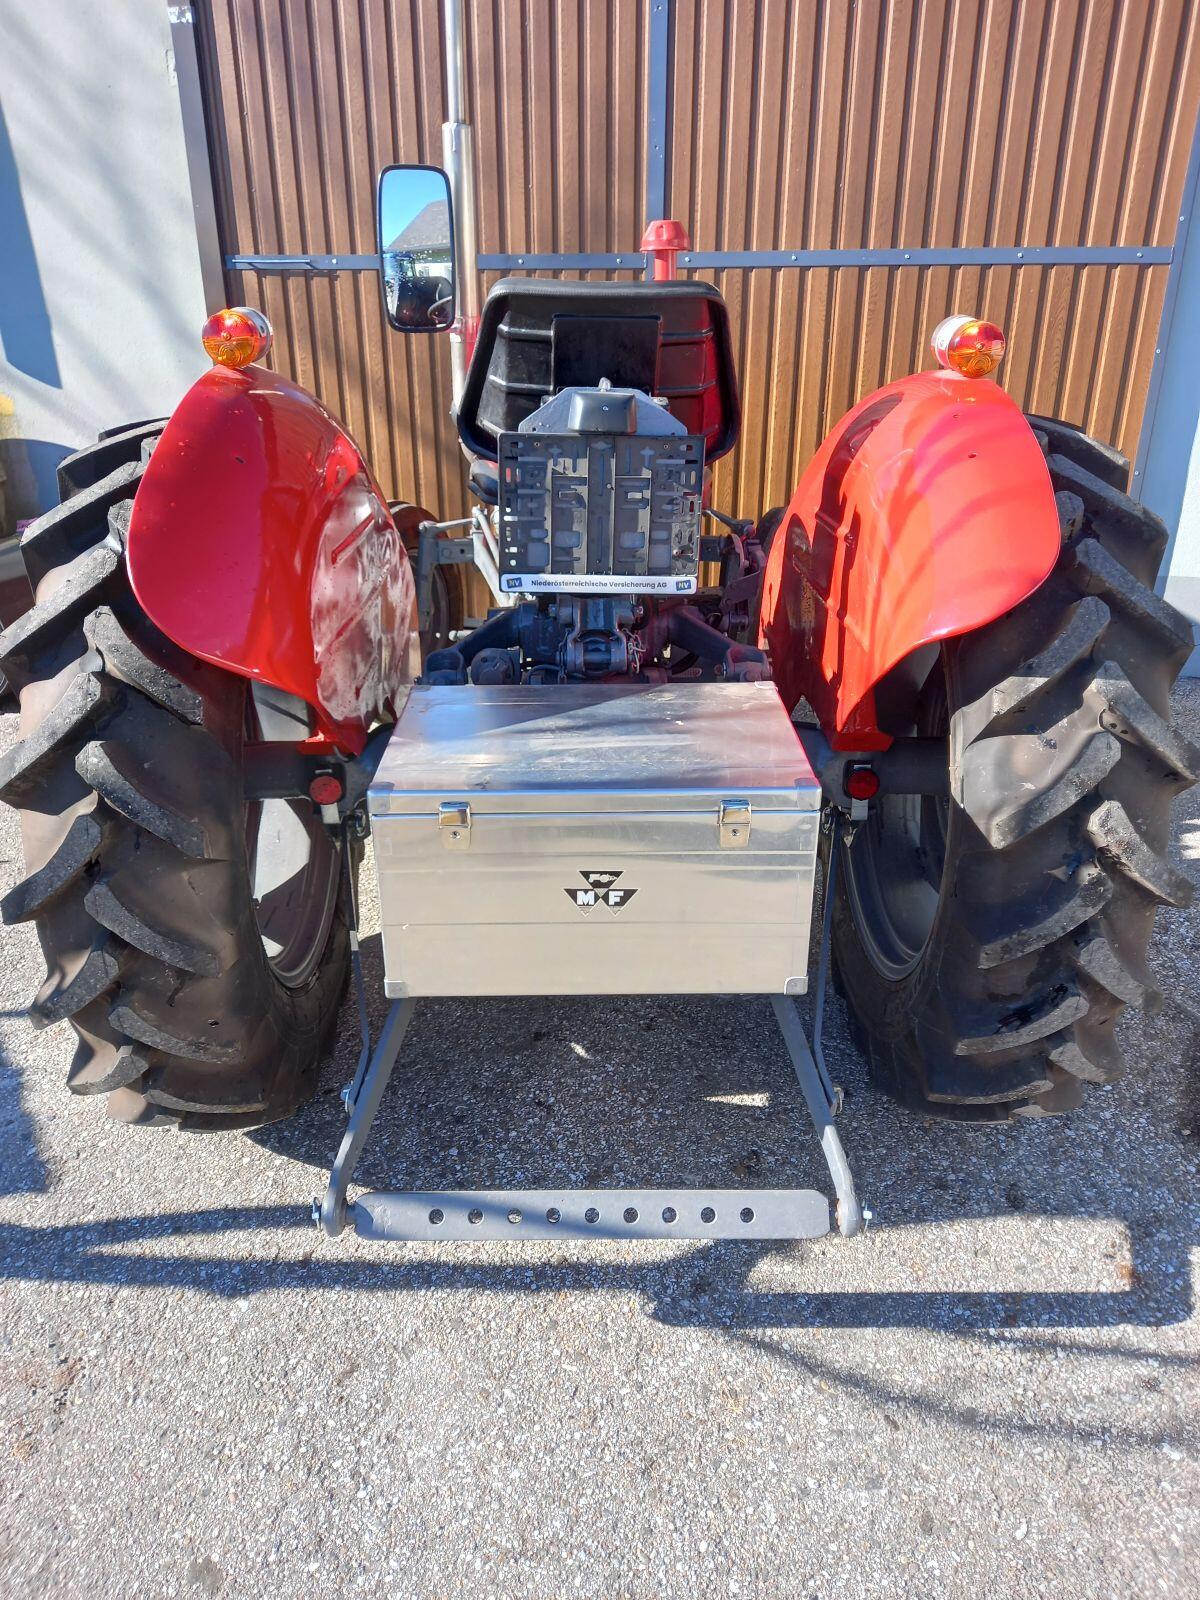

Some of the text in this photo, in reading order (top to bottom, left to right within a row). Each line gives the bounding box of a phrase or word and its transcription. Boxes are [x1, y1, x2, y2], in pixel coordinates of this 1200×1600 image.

[508, 579, 521, 588] NV
[531, 580, 607, 588] Niederösterreichische
[609, 581, 655, 589] Versicherung
[677, 580, 690, 589] NV
